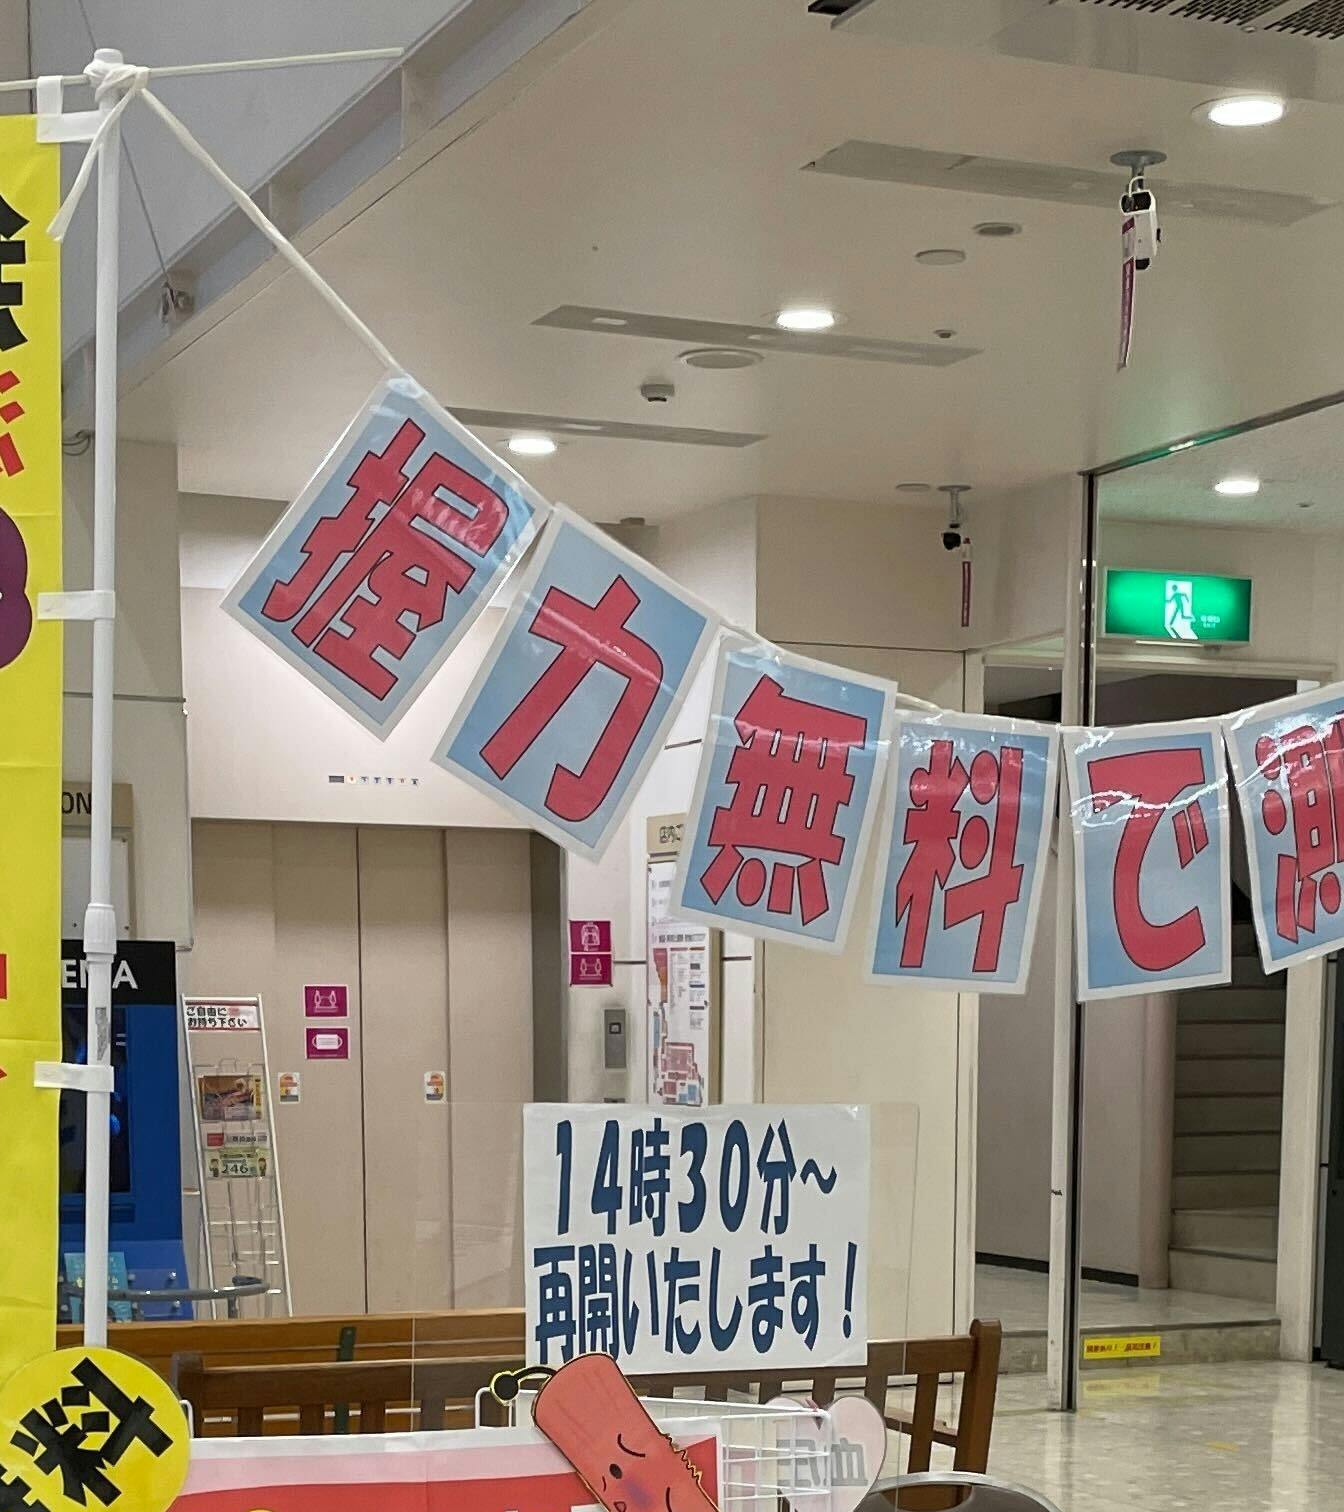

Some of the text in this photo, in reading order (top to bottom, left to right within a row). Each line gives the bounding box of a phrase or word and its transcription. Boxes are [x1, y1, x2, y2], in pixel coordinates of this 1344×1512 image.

[186, 1006, 228, 1017] ご自由に
[188, 1017, 248, 1028] お持ち下さい
[556, 1117, 838, 1236] 14時30分～
[533, 1241, 858, 1364] 再開いたします！
